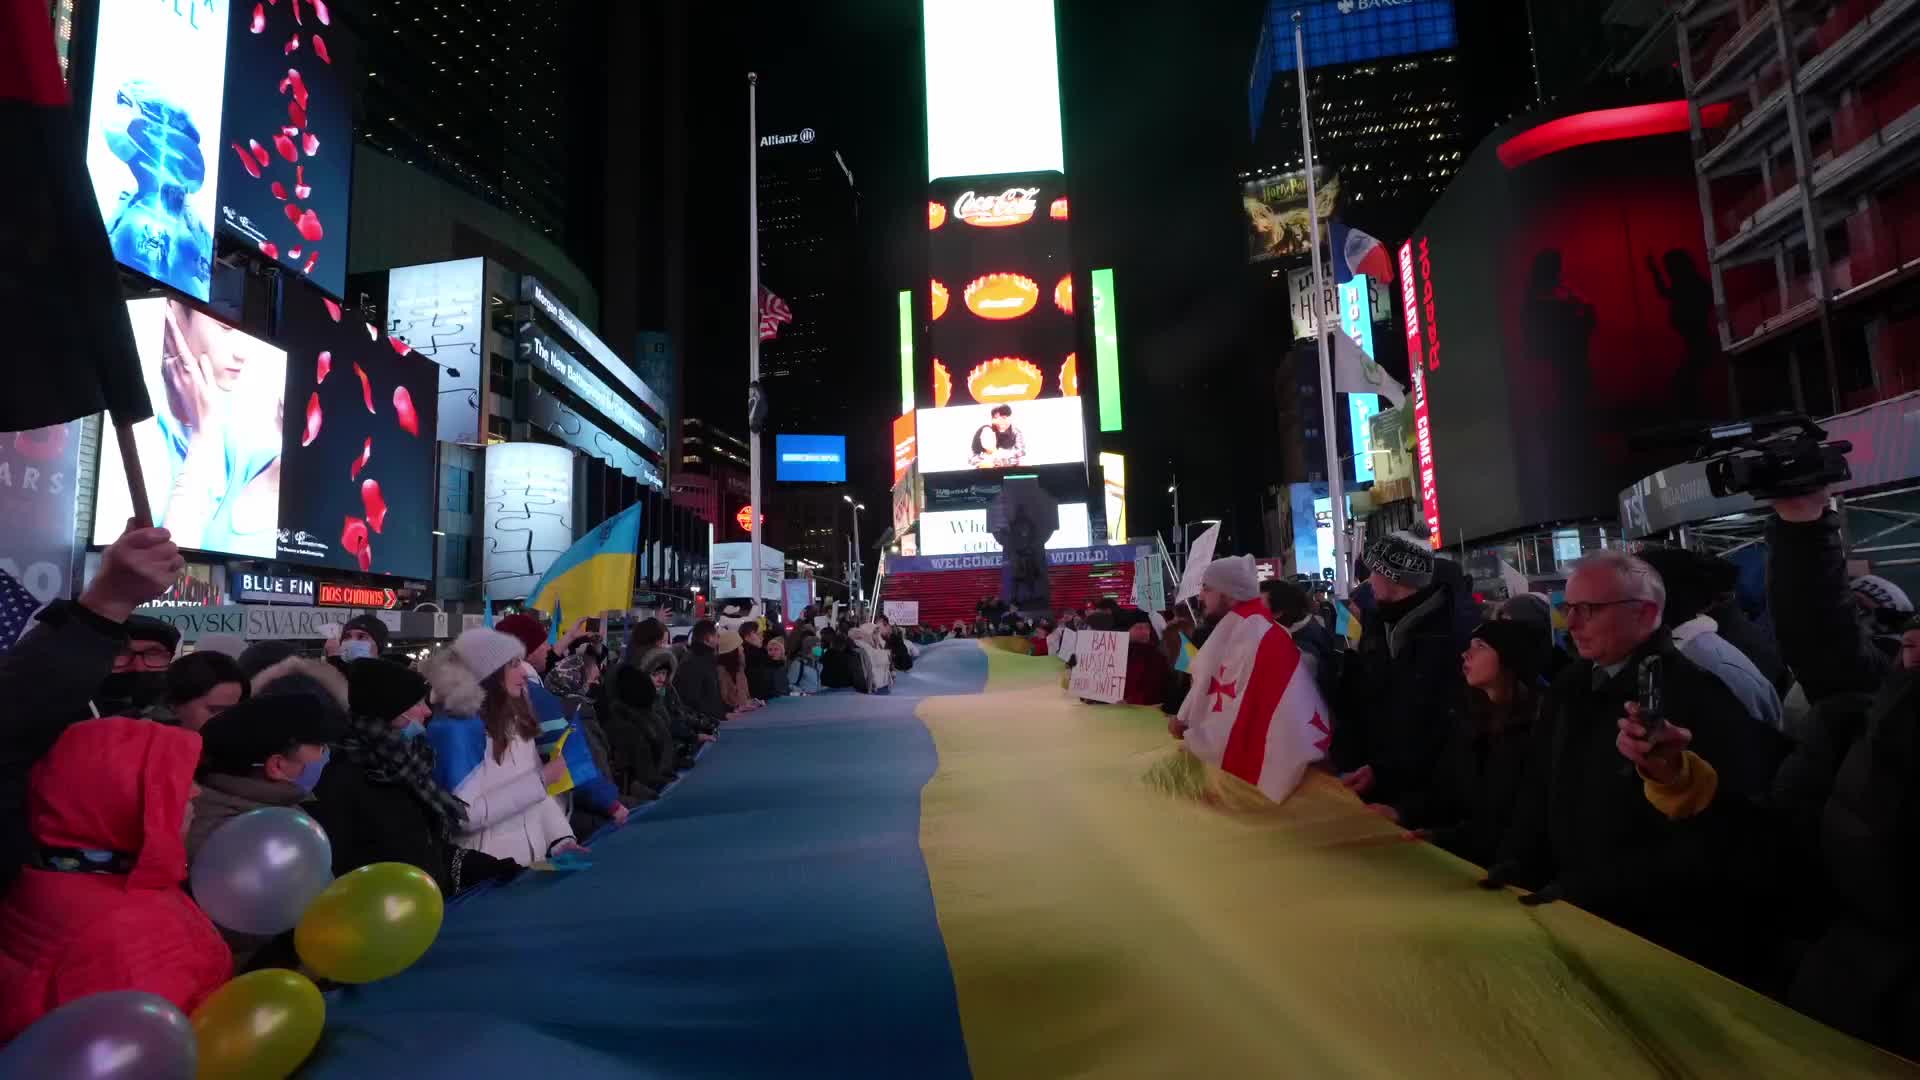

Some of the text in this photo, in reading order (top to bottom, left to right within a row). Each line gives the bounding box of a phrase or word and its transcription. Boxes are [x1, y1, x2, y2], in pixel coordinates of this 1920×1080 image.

[760, 134, 799, 147] Allianz
[953, 187, 1040, 218] Coca-Cola
[535, 286, 558, 316] Morgan
[534, 337, 549, 362] The
[550, 351, 567, 375] New
[1400, 242, 1419, 339] CHOCOLATE
[1417, 415, 1432, 467] COME
[931, 549, 1109, 570] WELCOME WORLD!
[1371, 560, 1401, 582] FACE
[243, 575, 313, 594] BLUE FIN
[1092, 632, 1116, 652] BAN
